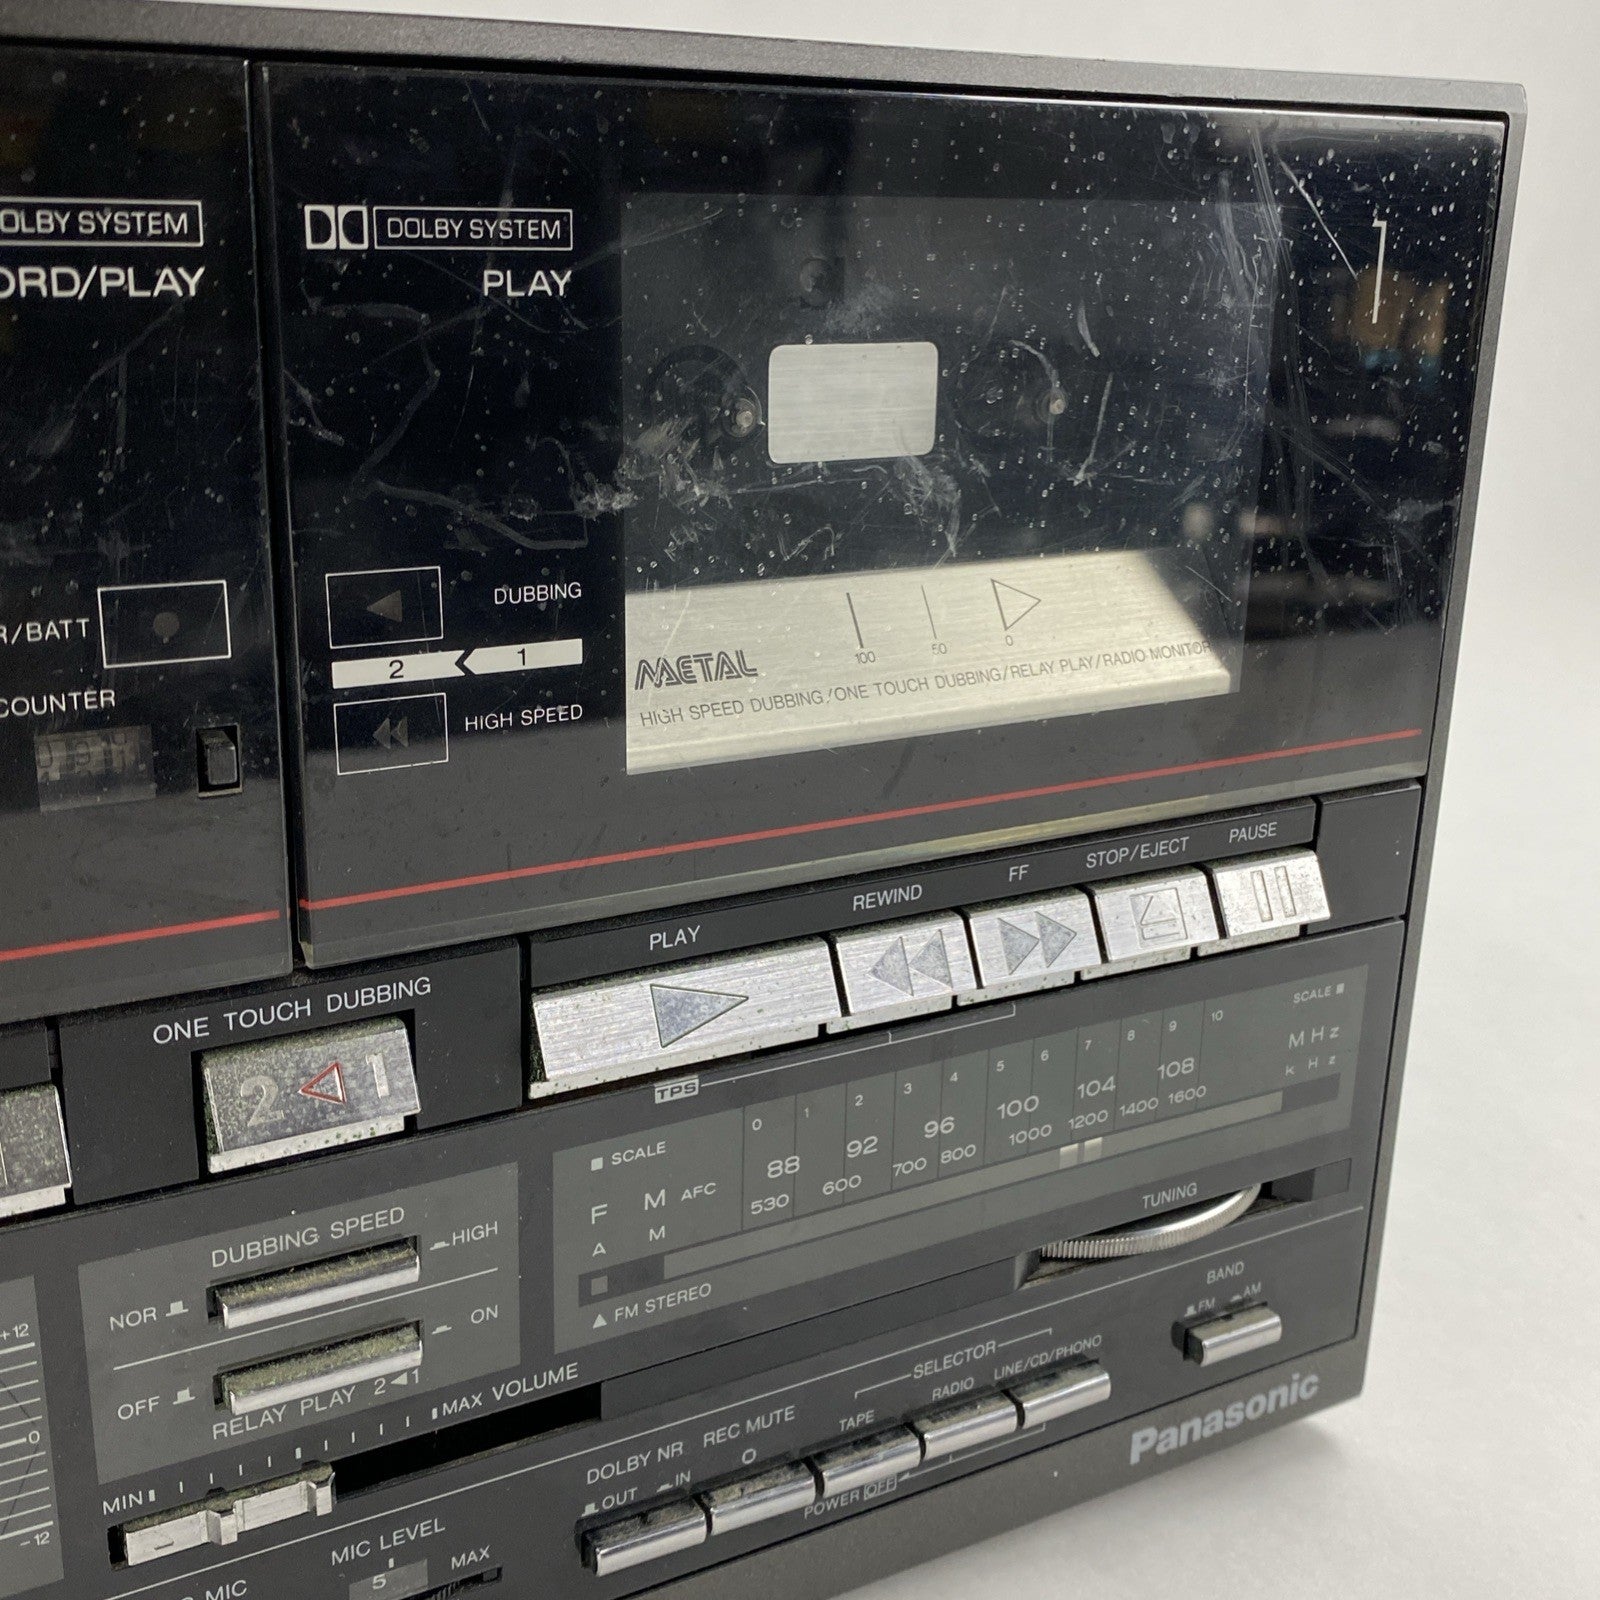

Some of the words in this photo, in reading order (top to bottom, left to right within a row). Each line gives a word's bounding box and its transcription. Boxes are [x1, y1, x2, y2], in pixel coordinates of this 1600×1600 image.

[77, 210, 188, 235] SYSTEM
[386, 217, 463, 239] DOLBY
[469, 218, 561, 240] SYSTEM
[483, 268, 571, 297] PLAY
[494, 582, 582, 605] DUBBING
[389, 660, 405, 679] 2
[517, 648, 526, 666] 1
[634, 649, 759, 691] METAL
[855, 650, 876, 664] 100
[640, 707, 684, 728] HIGH
[688, 699, 745, 722] SPEED
[877, 676, 930, 698] TOUCH
[935, 661, 1055, 690] DUBBING/RELAY
[1060, 648, 1146, 672] PLAY/RADIO
[1149, 639, 1213, 661] MONITOR
[464, 712, 513, 732] HIGH
[521, 704, 583, 726] SPEED
[1228, 821, 1278, 844] PAUSE
[1086, 836, 1189, 870] STOP/EJECT
[1008, 864, 1029, 883] FF
[852, 883, 923, 912] REWIND
[649, 924, 701, 951] PLAY
[1292, 985, 1332, 1005] SCALE
[152, 1016, 211, 1046] ONE
[223, 998, 312, 1032] TOUCH
[327, 976, 432, 1013] DUBBING
[751, 1118, 763, 1132] 0
[854, 1094, 864, 1107] 2
[903, 1082, 912, 1095] 3
[949, 1071, 959, 1083] 4
[996, 1060, 1005, 1073] 5
[1040, 1049, 1049, 1062] 6
[1085, 1039, 1093, 1051] 7
[1127, 1029, 1136, 1042] 8
[1169, 1020, 1178, 1032] 9
[1212, 1010, 1224, 1023] 10
[240, 1074, 285, 1128] 2
[365, 1051, 390, 1100] 1
[656, 1082, 699, 1100] TPS
[766, 1156, 801, 1180] 88
[846, 1137, 879, 1159] 92
[924, 1117, 955, 1139] 96
[997, 1095, 1040, 1120] 100
[1077, 1075, 1116, 1100] 104
[1156, 1057, 1195, 1081] 108
[611, 1142, 667, 1167] SCALE
[750, 1195, 790, 1216] 530
[822, 1175, 862, 1196] 600
[892, 1158, 928, 1177] 700
[940, 1144, 977, 1164] 800
[1008, 1124, 1053, 1146] 1000
[1068, 1110, 1110, 1131] 1200
[1119, 1097, 1160, 1118] 1400
[1168, 1085, 1207, 1105] 1600
[591, 1205, 608, 1225] F
[681, 1182, 717, 1202] AFC
[1142, 1182, 1198, 1210] TUNING
[211, 1228, 319, 1269] DUBBING
[330, 1206, 405, 1241] SPEED
[452, 1221, 499, 1247] HIGH
[1206, 1260, 1245, 1285] BAND
[613, 1305, 640, 1323] FM
[645, 1282, 713, 1315] STEREO
[1198, 1296, 1216, 1312] FM
[1242, 1281, 1262, 1299] AM
[110, 1306, 157, 1331] NOR
[471, 1305, 499, 1325] ON
[913, 1340, 996, 1380] SELECTOR
[994, 1334, 1102, 1381] LINE/CD/PHONO
[443, 1390, 484, 1418] MAX
[492, 1361, 580, 1402] VOLUME
[932, 1376, 974, 1401] RADIO
[117, 1395, 160, 1421] OFF
[212, 1406, 288, 1441] RELAY
[300, 1384, 357, 1418] PLAY
[374, 1377, 387, 1396] 2
[838, 1409, 875, 1433] TAPE
[1129, 1373, 1319, 1465] Panasonic
[703, 1422, 741, 1449] REC
[746, 1405, 796, 1434] MUTE
[586, 1450, 652, 1486] DOLBY
[657, 1441, 684, 1464] NR
[102, 1489, 144, 1516] MIN
[602, 1486, 639, 1511] OUT
[675, 1470, 692, 1487] IN
[804, 1489, 860, 1520] POWER
[866, 1477, 895, 1498] OFF
[331, 1540, 371, 1567] MIC
[379, 1517, 446, 1551] LEVEL
[451, 1544, 491, 1571] MAX
[205, 1579, 248, 1600] MIC
[372, 1573, 387, 1590] 5
